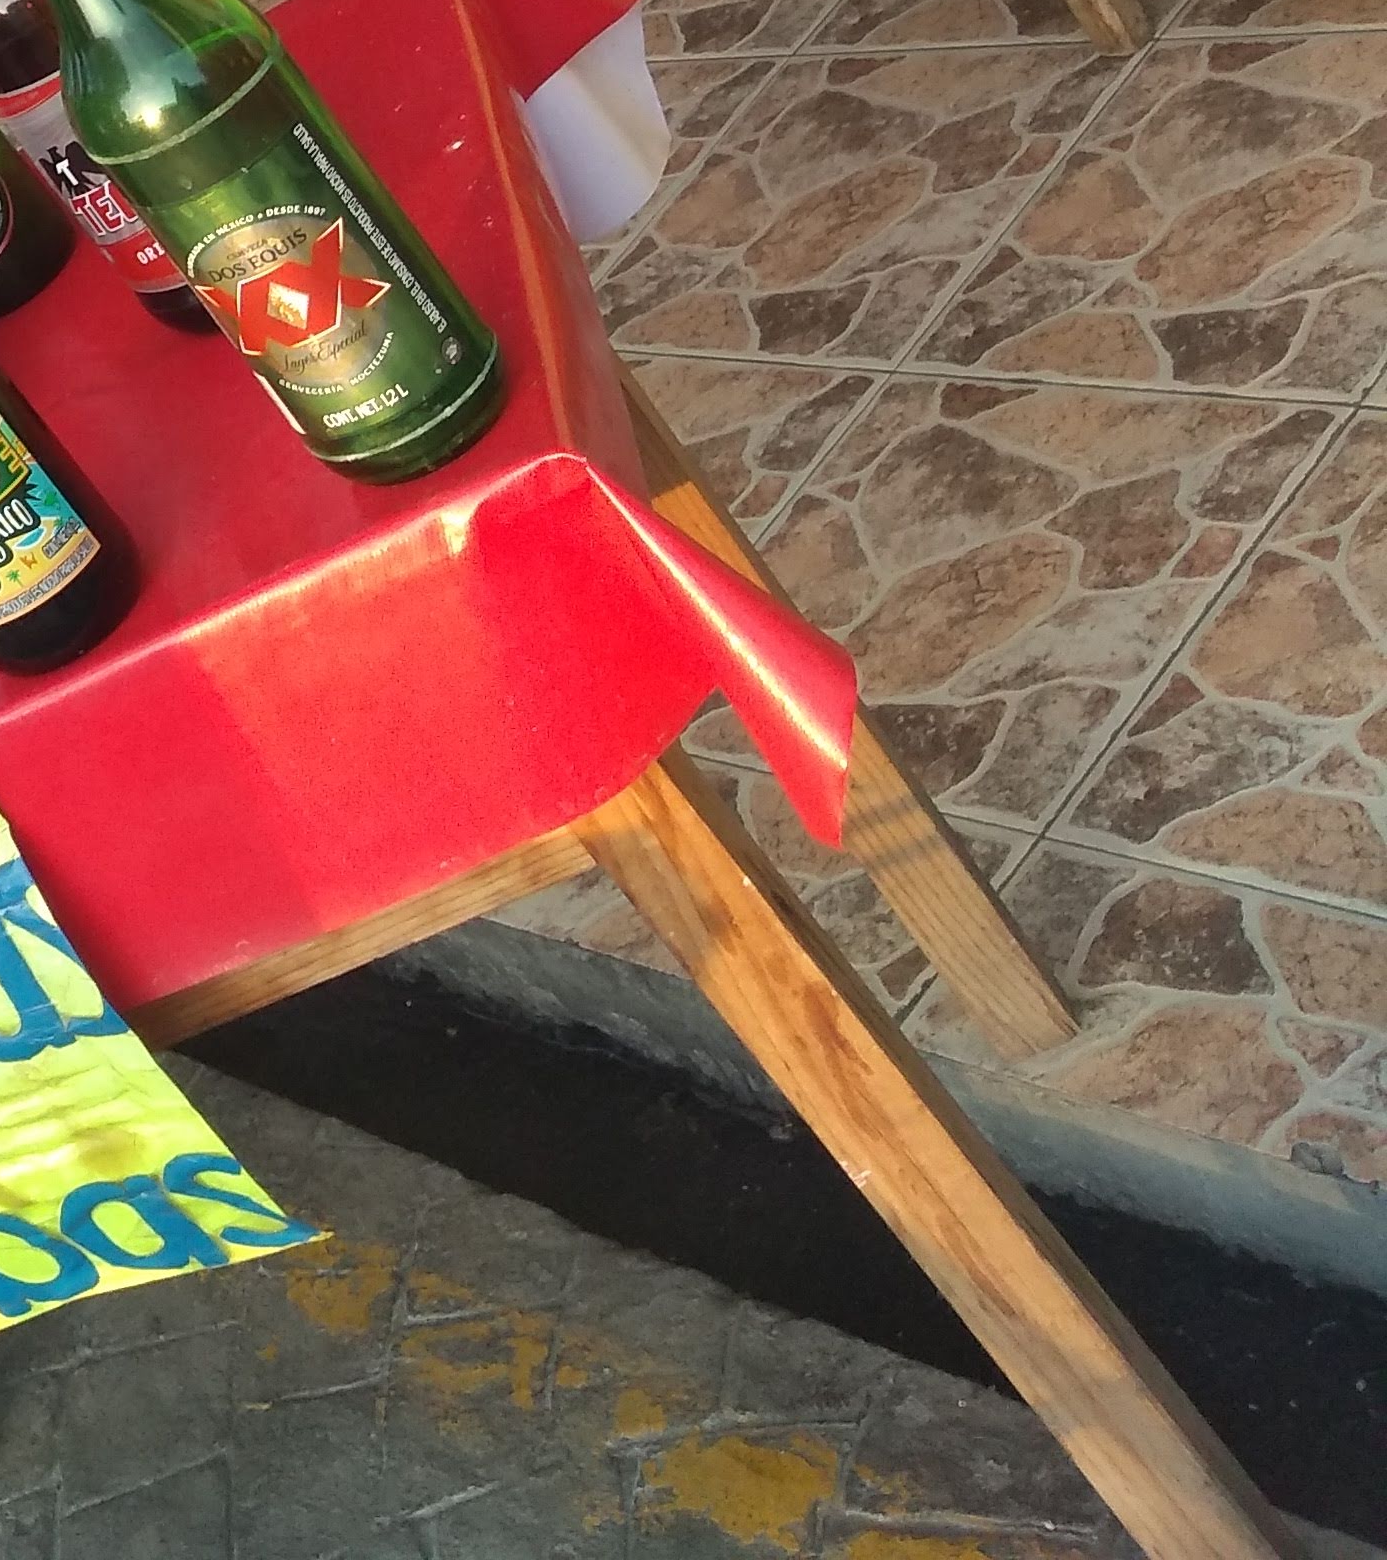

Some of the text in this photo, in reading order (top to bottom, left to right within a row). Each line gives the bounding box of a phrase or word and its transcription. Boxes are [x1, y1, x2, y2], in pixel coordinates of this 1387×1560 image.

[265, 204, 301, 219] DESDE
[344, 195, 377, 235] PRODUCTO
[136, 241, 166, 266] ORI
[208, 228, 308, 284] DOS EQUIS
[367, 227, 388, 250] ESTE
[282, 319, 368, 375] Lager Especial
[349, 331, 394, 386] MOCTEZUMA
